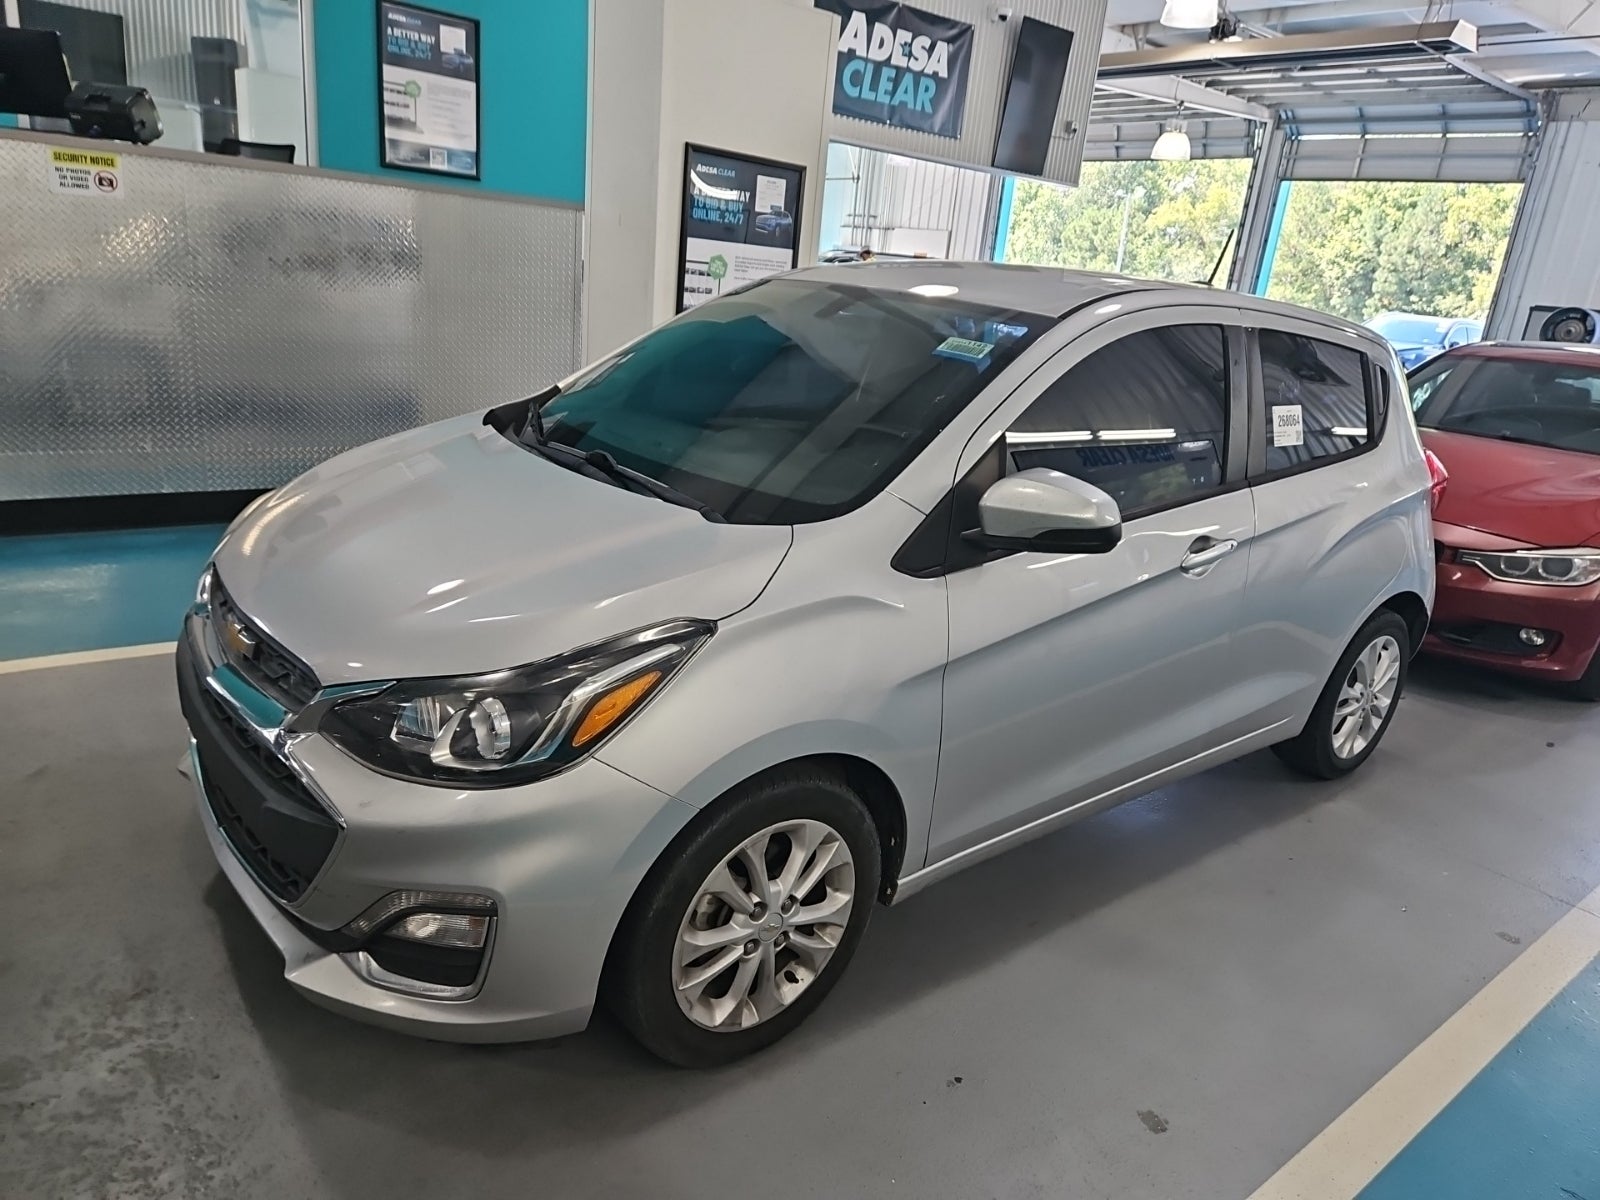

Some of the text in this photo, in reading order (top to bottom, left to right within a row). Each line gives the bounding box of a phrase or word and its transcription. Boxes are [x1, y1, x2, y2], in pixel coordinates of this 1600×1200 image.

[387, 26, 435, 45] A BETTER WAY
[838, 10, 949, 79] ADESA
[842, 58, 937, 114] CLEAR
[53, 151, 116, 167] SECURITY NOTICE
[66, 167, 91, 176] PHOTOS
[695, 163, 736, 178] ADESA CLEAR
[59, 181, 89, 189] ALLOWED
[694, 196, 704, 207] TO
[705, 198, 719, 209] BID
[728, 200, 744, 212] BUY
[692, 207, 744, 225] ONLINE, 24/7
[1278, 414, 1300, 427] 268064
